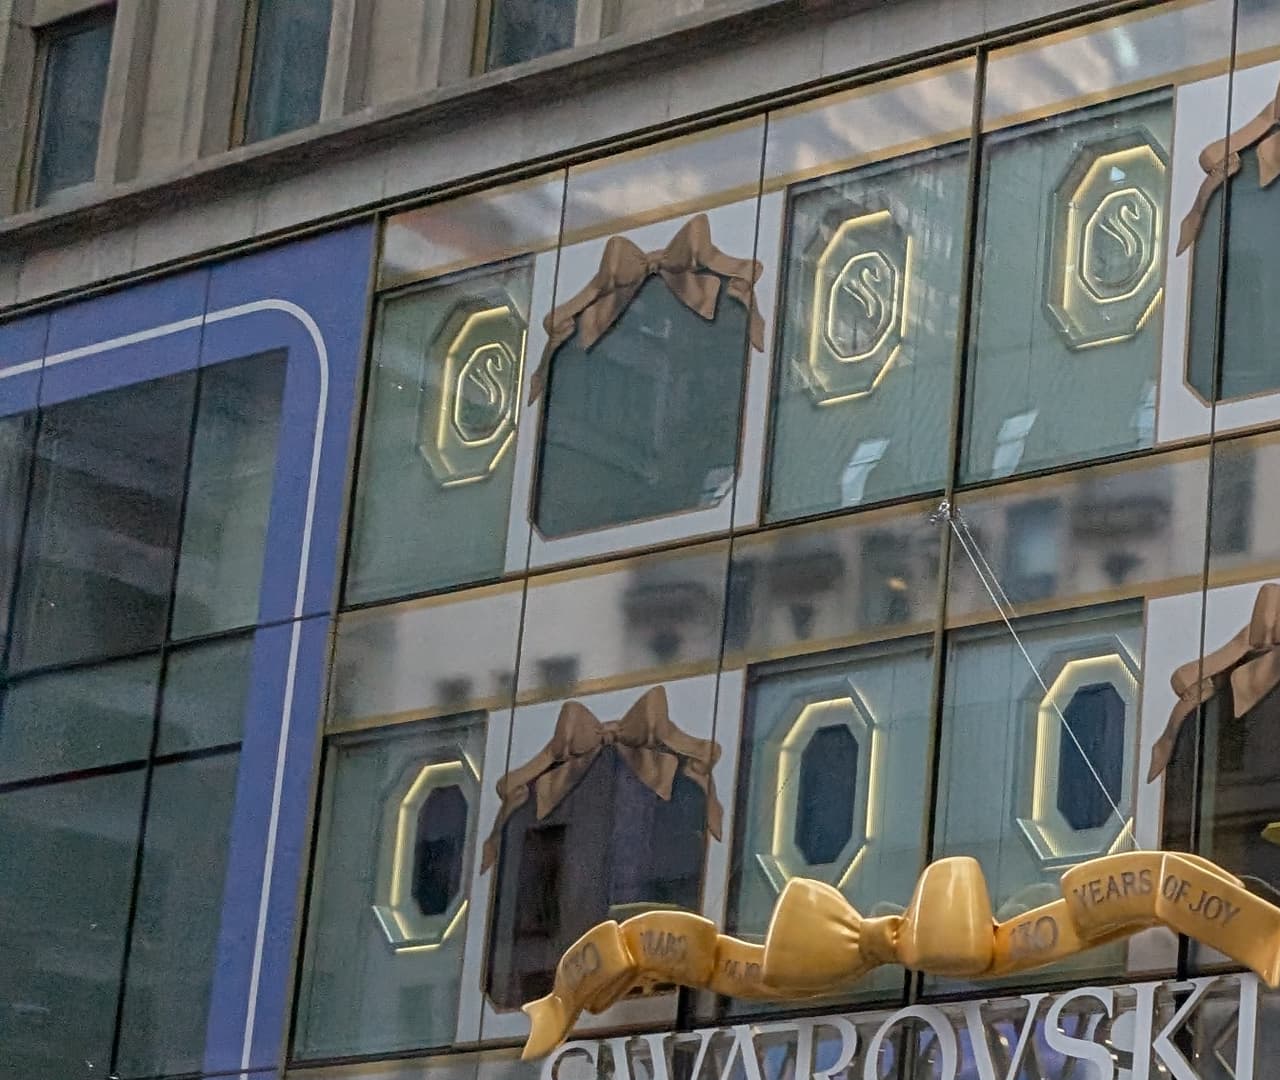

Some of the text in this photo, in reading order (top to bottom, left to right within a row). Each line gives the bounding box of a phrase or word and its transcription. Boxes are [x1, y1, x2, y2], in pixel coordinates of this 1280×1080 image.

[1073, 868, 1153, 910] YEARS
[1163, 874, 1192, 901] OF
[1189, 890, 1241, 927] JOY
